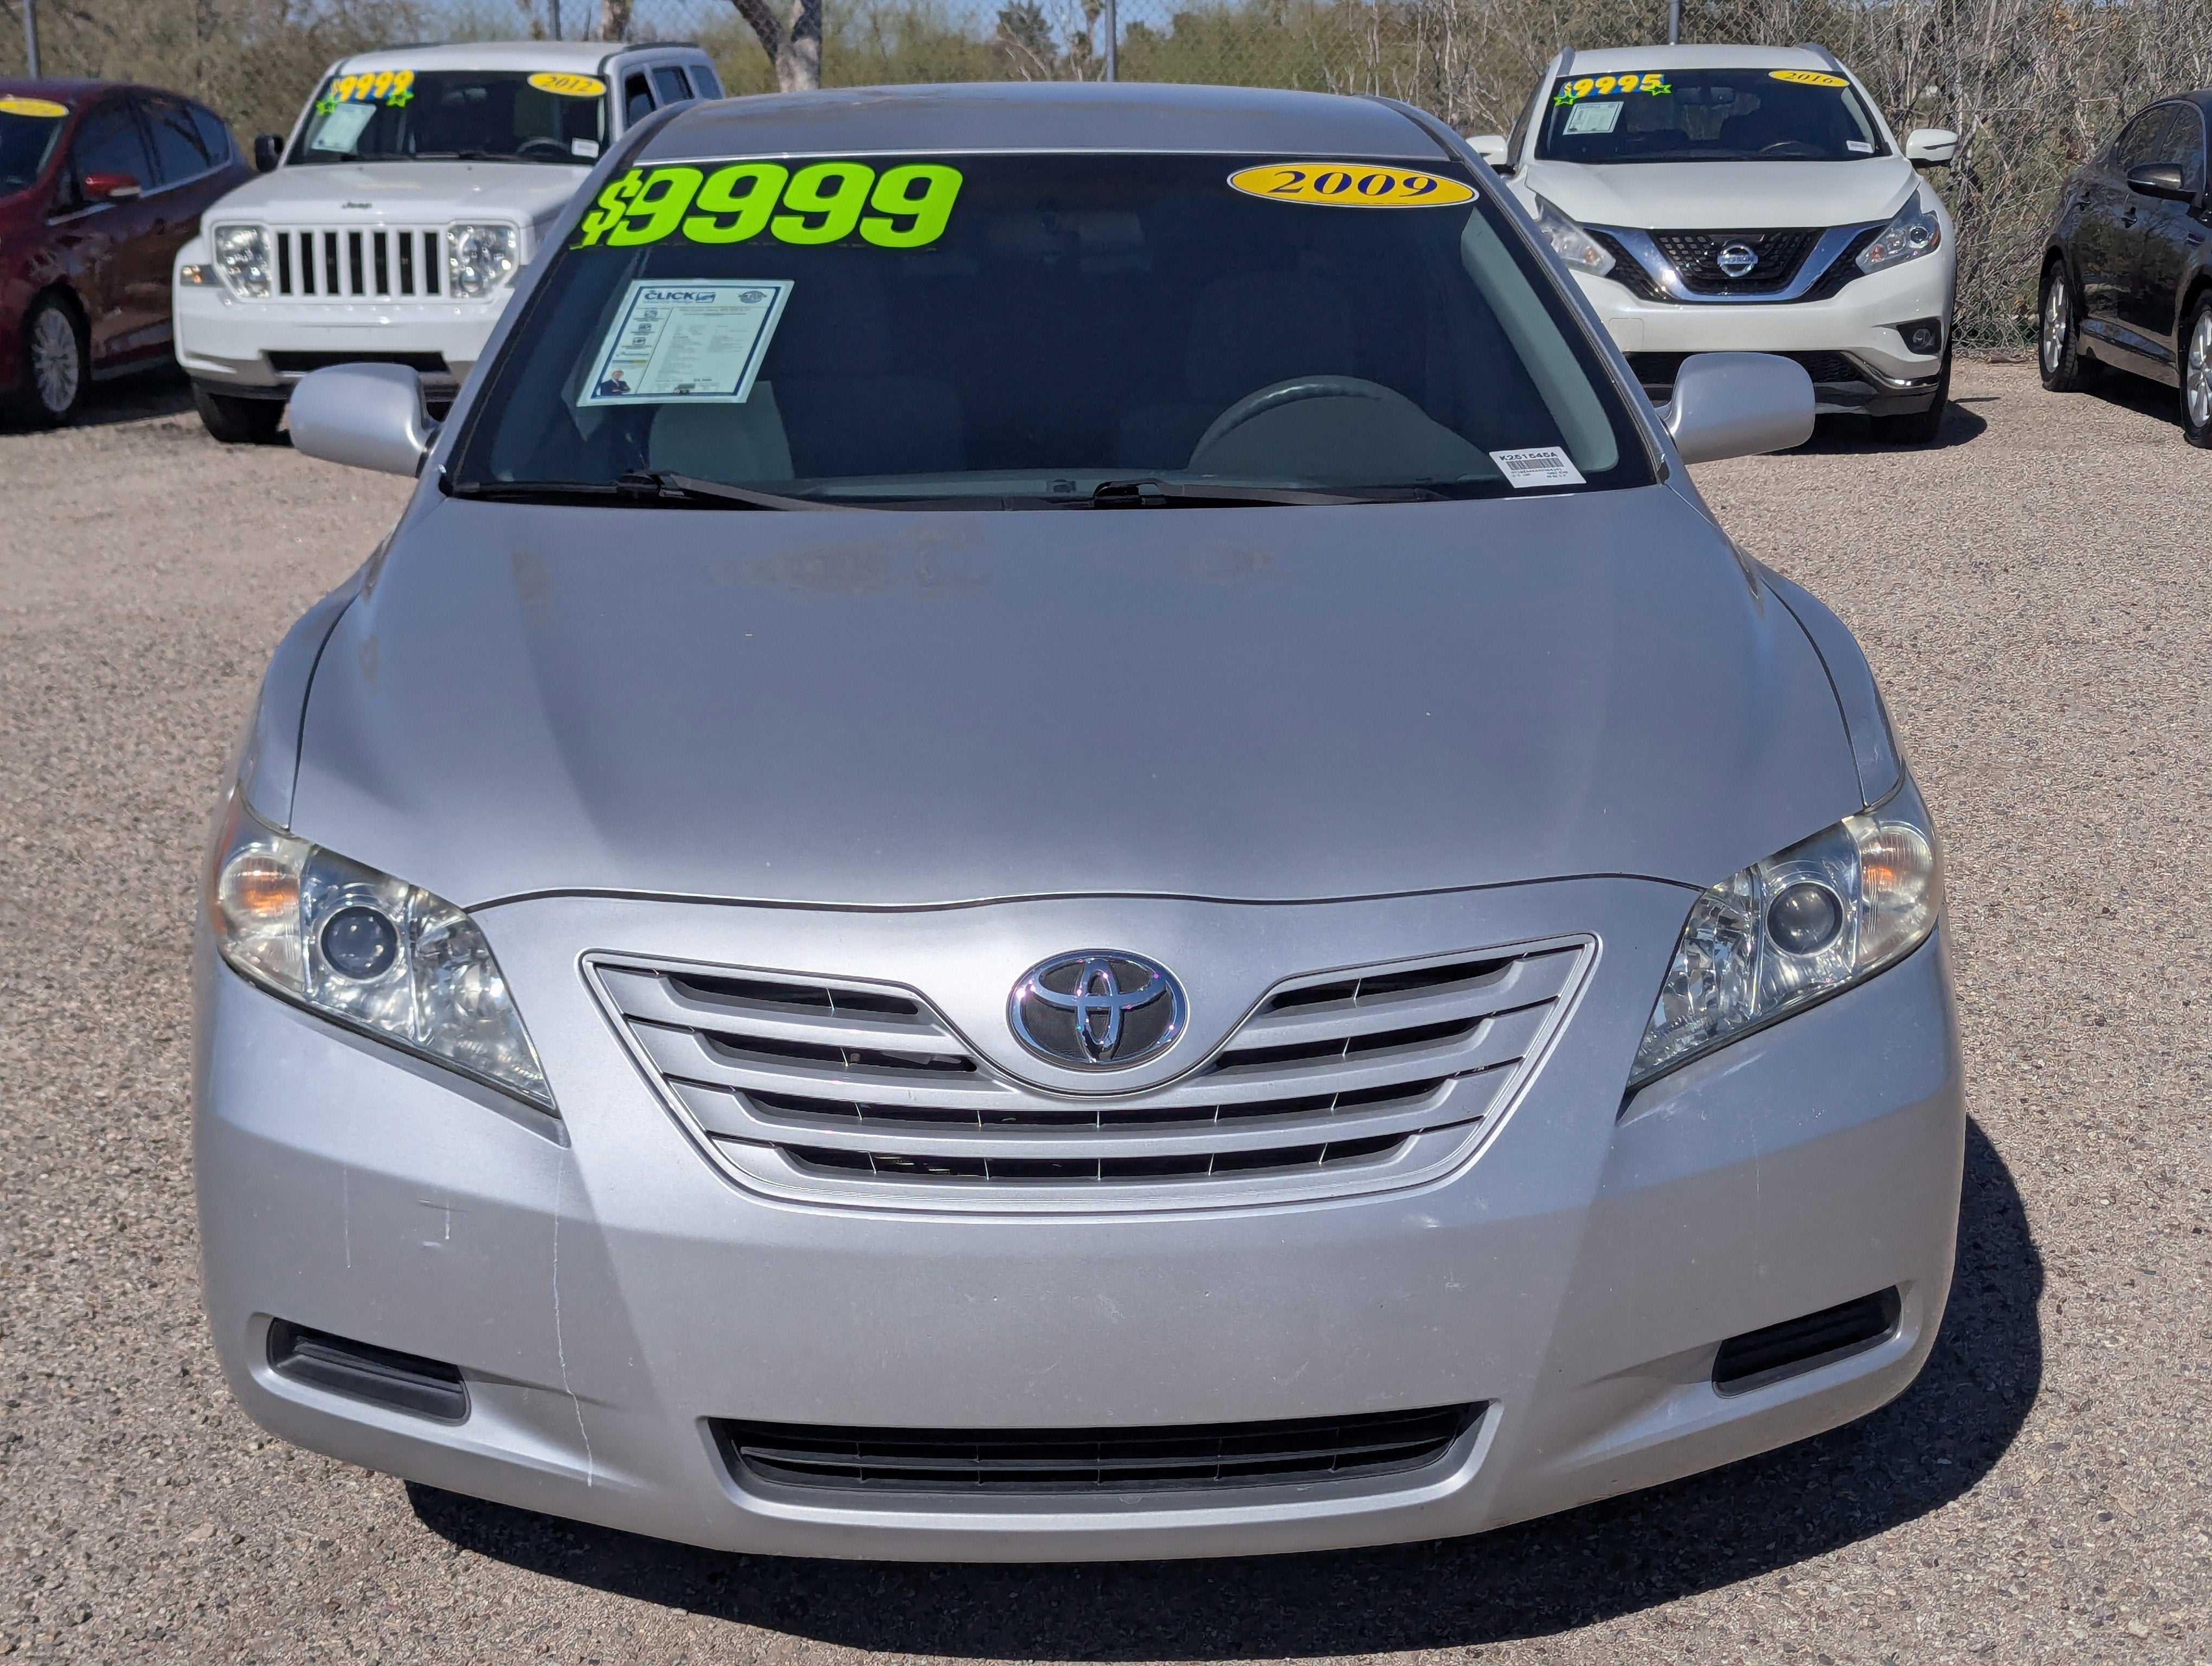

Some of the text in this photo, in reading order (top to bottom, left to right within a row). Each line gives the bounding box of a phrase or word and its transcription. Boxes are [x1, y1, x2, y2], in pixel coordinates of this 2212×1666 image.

[541, 76, 593, 92] 2012
[1266, 170, 1438, 197] 2009
[568, 163, 963, 250] $9999
[644, 292, 695, 300] CLICK
